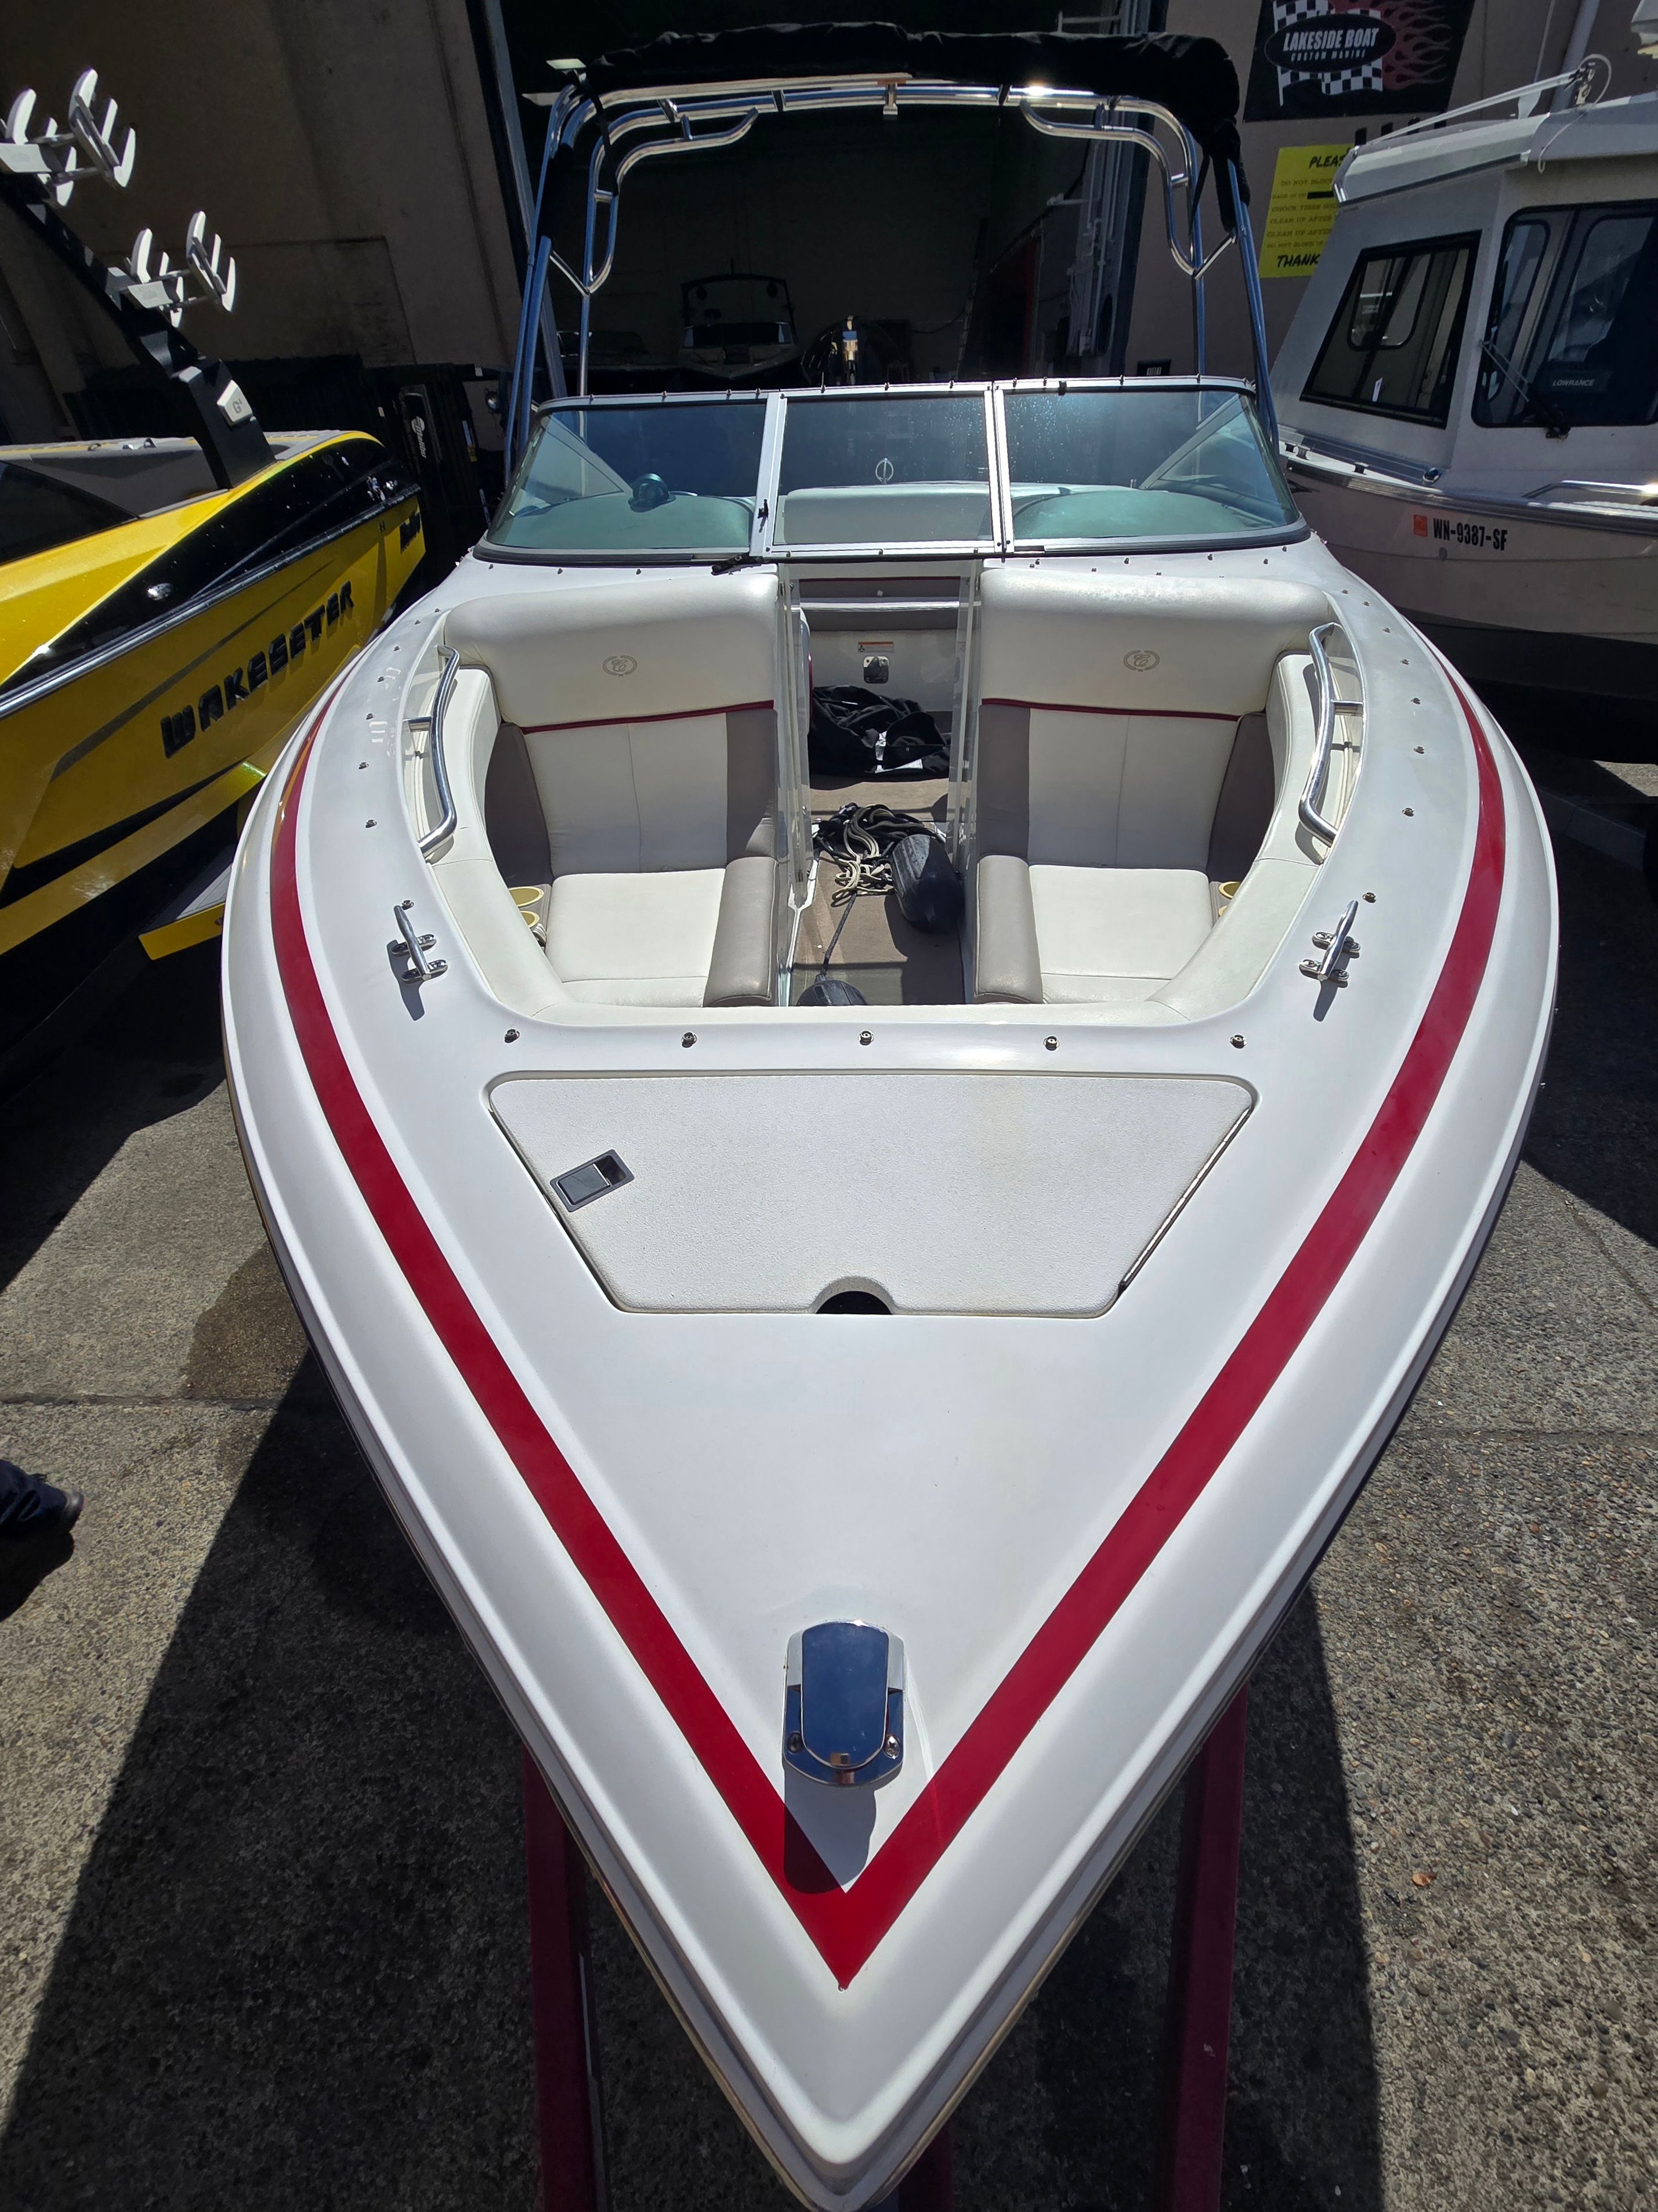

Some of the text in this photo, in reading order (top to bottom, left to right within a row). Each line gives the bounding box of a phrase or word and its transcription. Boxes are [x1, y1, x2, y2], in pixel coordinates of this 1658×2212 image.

[1283, 28, 1379, 51] LAKESIDE BOAT
[1291, 49, 1366, 62] CUSTOM MARINE
[1277, 253, 1320, 268] THANK
[1433, 518, 1507, 551] WN-9387-SF
